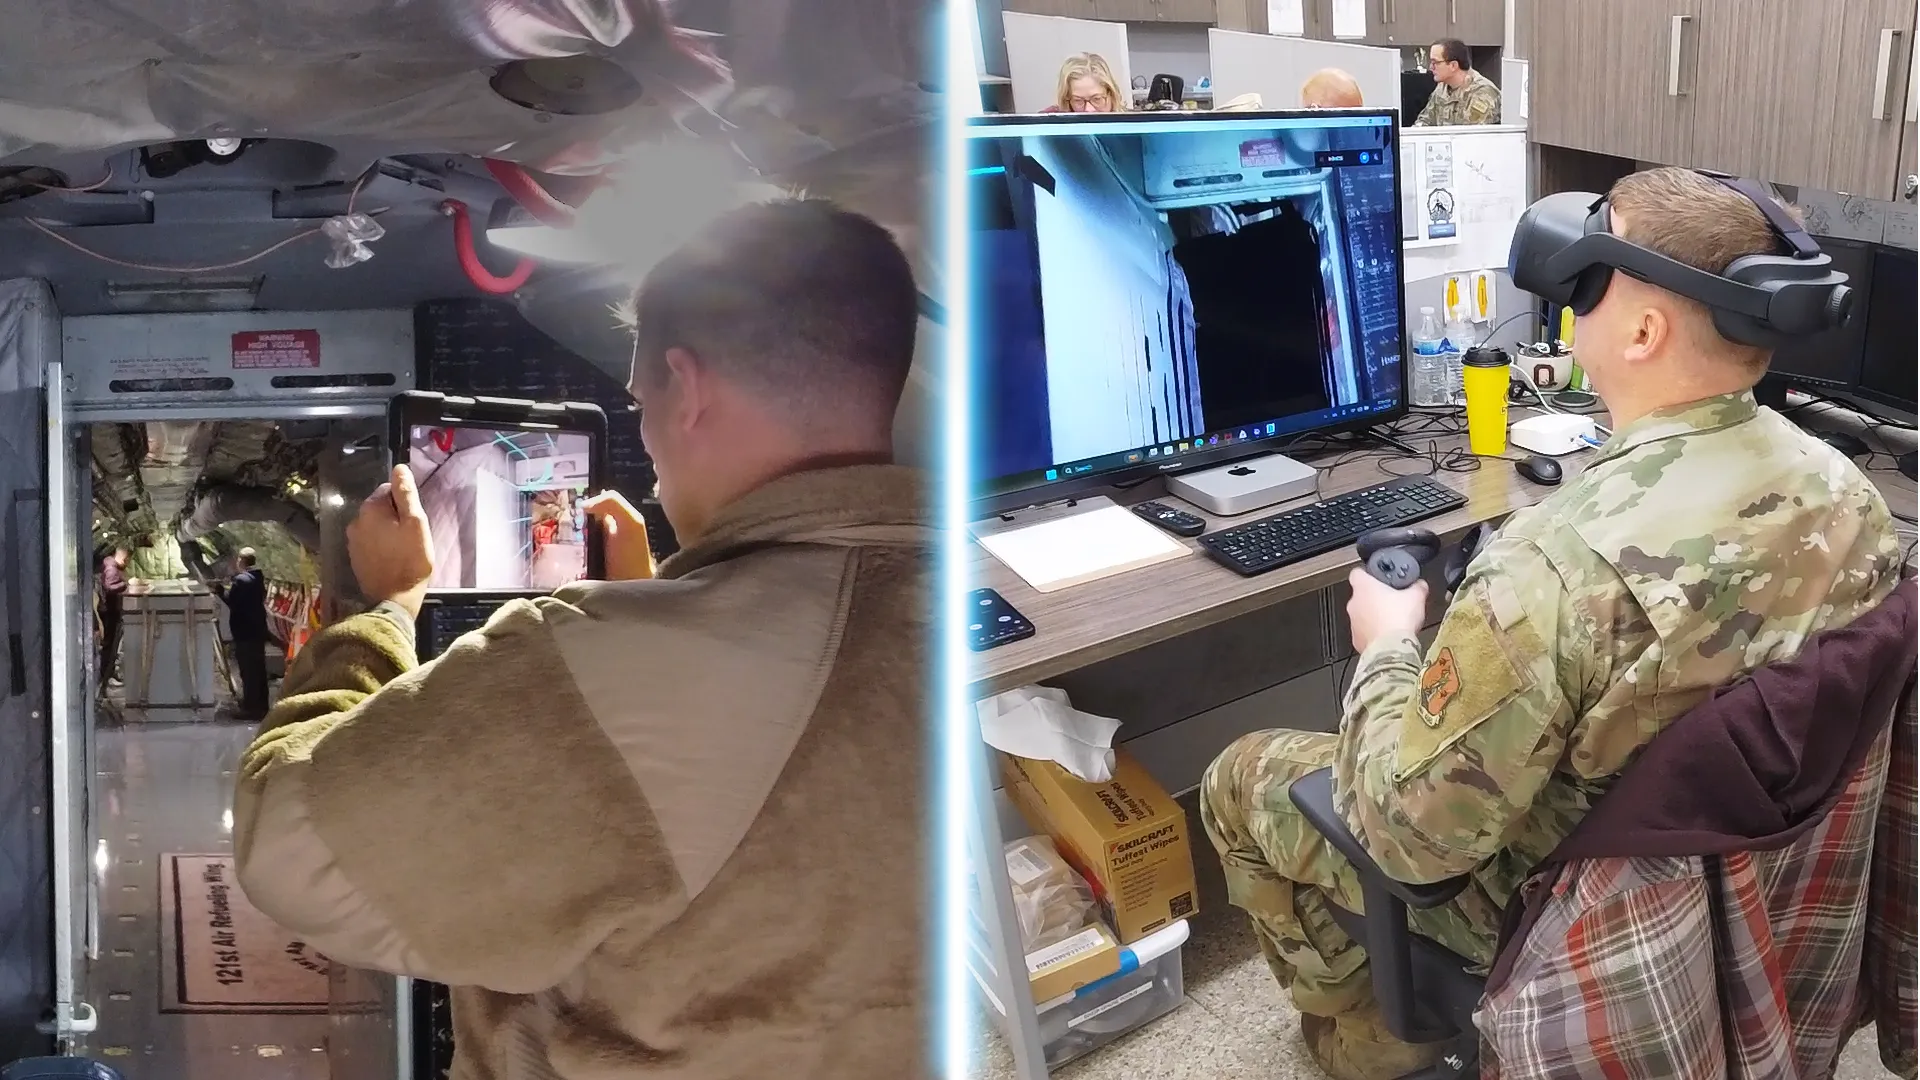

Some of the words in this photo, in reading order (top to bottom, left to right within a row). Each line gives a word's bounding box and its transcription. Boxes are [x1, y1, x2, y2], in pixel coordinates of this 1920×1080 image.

[247, 341, 268, 349] HIGH
[1094, 789, 1129, 823] SKILCRAFT
[1111, 847, 1149, 866] Tuffest
[1149, 835, 1180, 852] Wipes
[1116, 824, 1175, 853] SKILCRAFT
[203, 864, 226, 882] Wing
[206, 885, 232, 928] Refueling
[211, 931, 237, 947] Air
[215, 950, 244, 986] 121st
